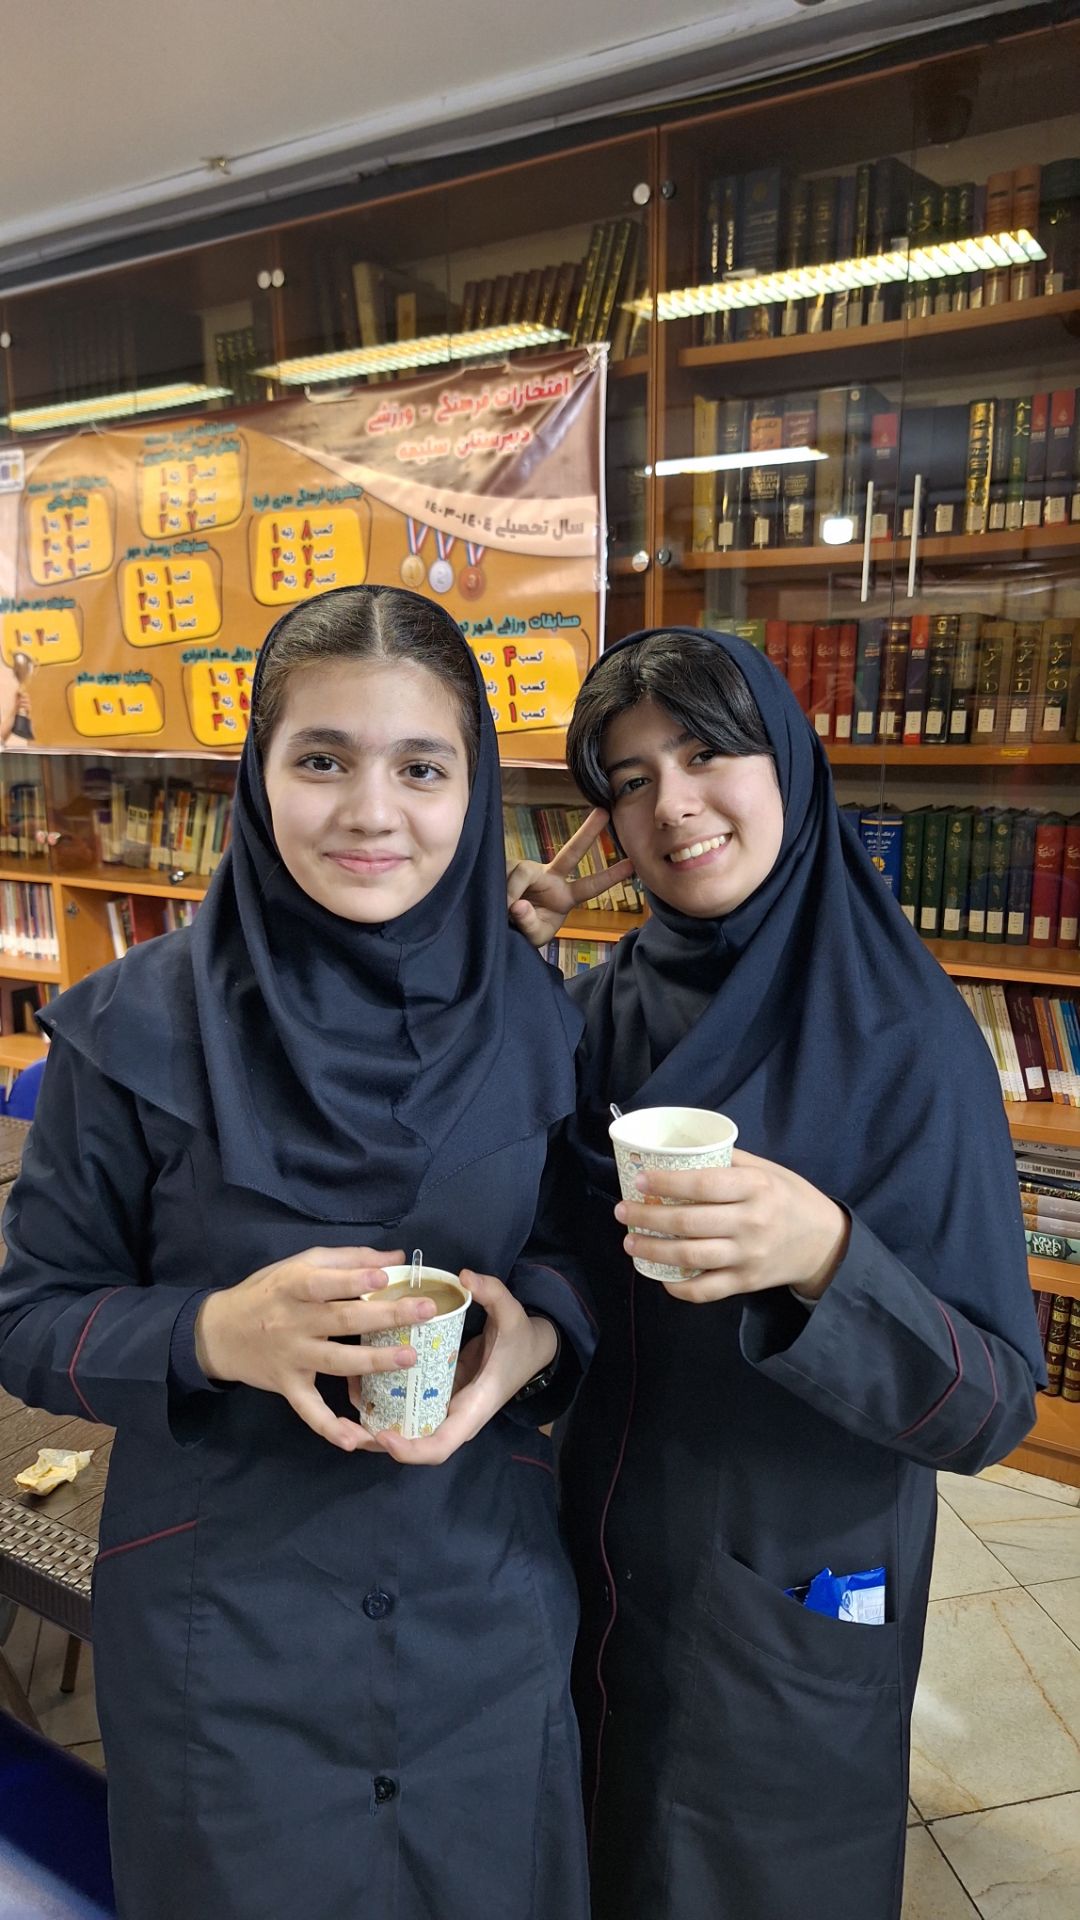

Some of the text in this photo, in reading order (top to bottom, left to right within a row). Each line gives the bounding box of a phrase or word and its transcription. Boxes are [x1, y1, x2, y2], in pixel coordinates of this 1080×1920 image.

[495, 375, 570, 411] افتخارات
[435, 388, 490, 423] فرهنگی
[368, 402, 415, 433] ورزشی
[397, 428, 531, 464] دبیرستان سلیمه
[272, 520, 333, 544] کسب ۸ رتبه ۱
[495, 519, 549, 539] تحصیلی
[552, 518, 585, 540] سال
[271, 544, 334, 568] کسب ۷ رتبه ۲
[137, 568, 144, 587] ۱
[165, 566, 172, 585] ۱
[174, 571, 190, 582] کسب
[272, 570, 284, 591] ۳
[284, 575, 297, 588] رتبه
[316, 573, 335, 585] کسب
[167, 590, 174, 610] ۱
[176, 595, 194, 606] کسب
[140, 615, 150, 633] ۳
[169, 613, 176, 632] ۱
[179, 618, 197, 629] کسب
[471, 616, 493, 636] شهر
[497, 616, 527, 635] ورزشی
[529, 612, 581, 632] مسابقات
[480, 645, 543, 667] کسب ۴ رتبه
[208, 668, 216, 687] ۱
[508, 674, 516, 696] ۱
[520, 680, 545, 693] کسب
[93, 697, 101, 716] ۱
[119, 697, 126, 716] ۱
[128, 703, 143, 713] کسب
[211, 692, 220, 710] ۲
[212, 713, 224, 731] ۳
[509, 702, 517, 723] ۱
[521, 708, 546, 720] کسب
